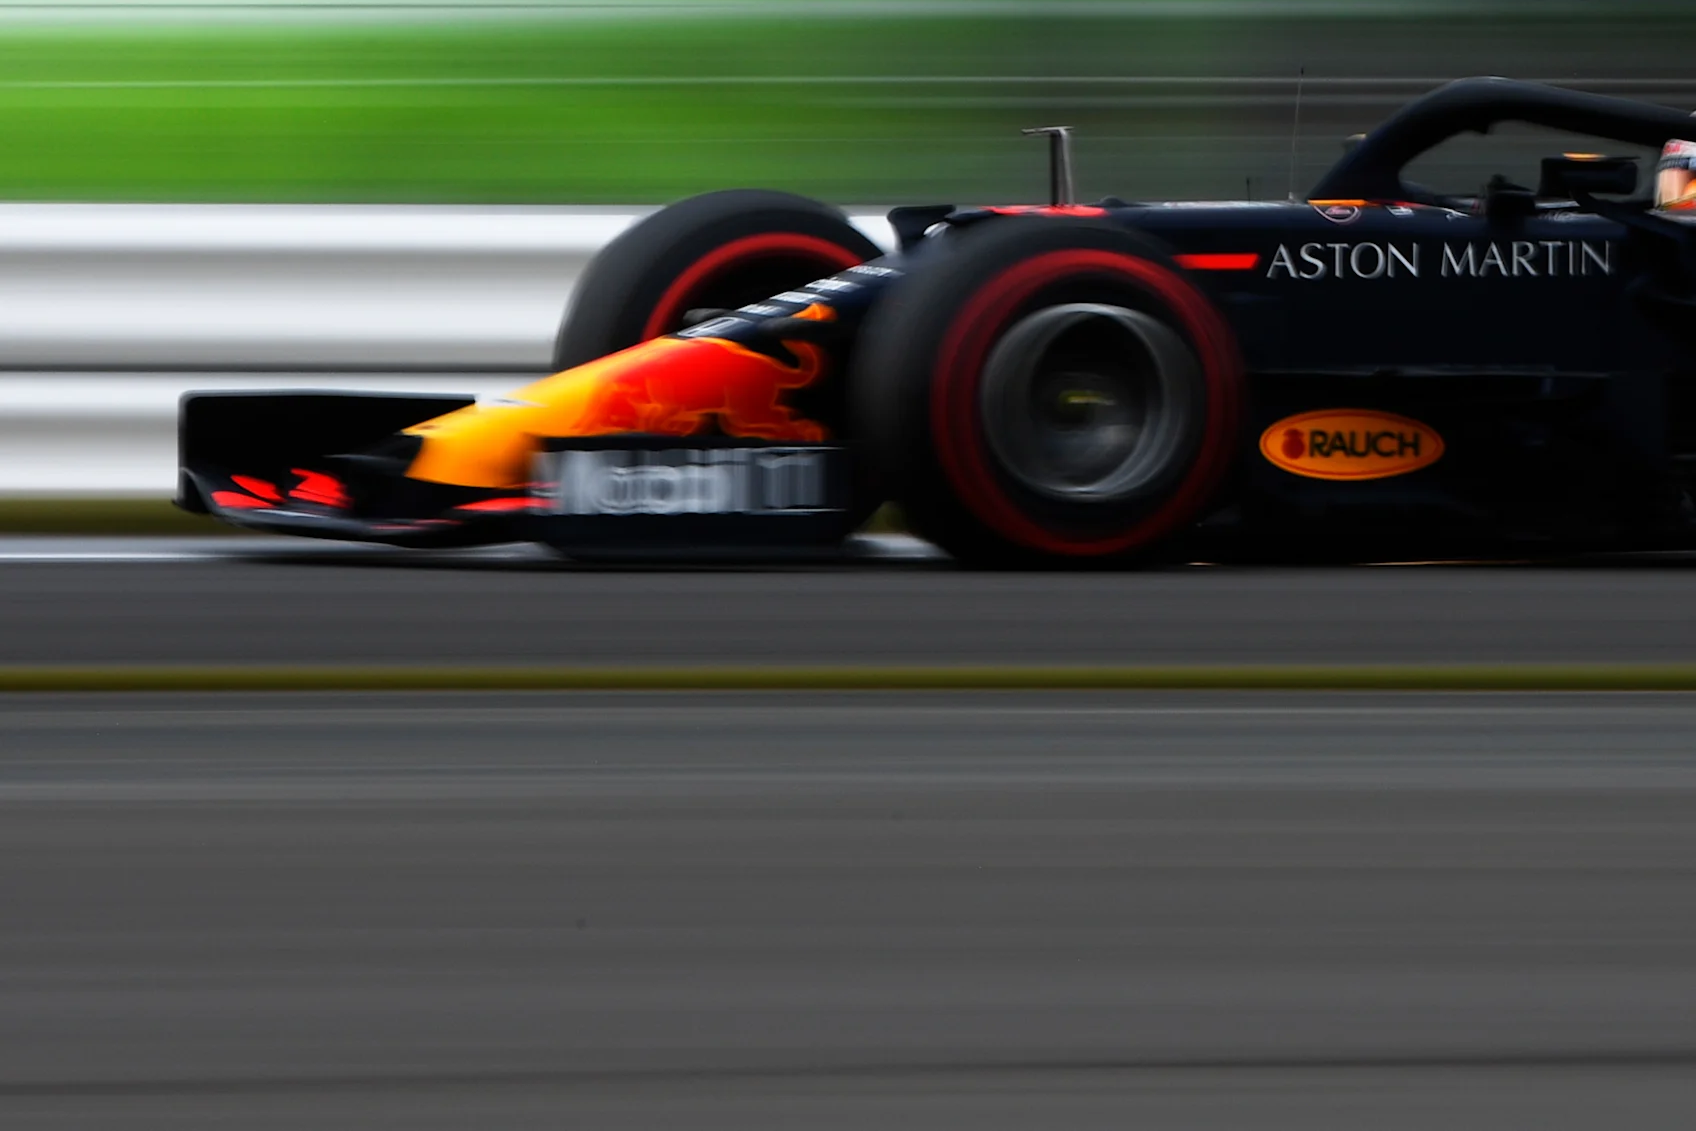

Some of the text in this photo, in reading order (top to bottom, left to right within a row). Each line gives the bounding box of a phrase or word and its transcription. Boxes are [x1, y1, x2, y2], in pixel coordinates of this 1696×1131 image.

[1266, 240, 1613, 279] ASTON MARTIN
[1308, 429, 1421, 458] RAUCH
